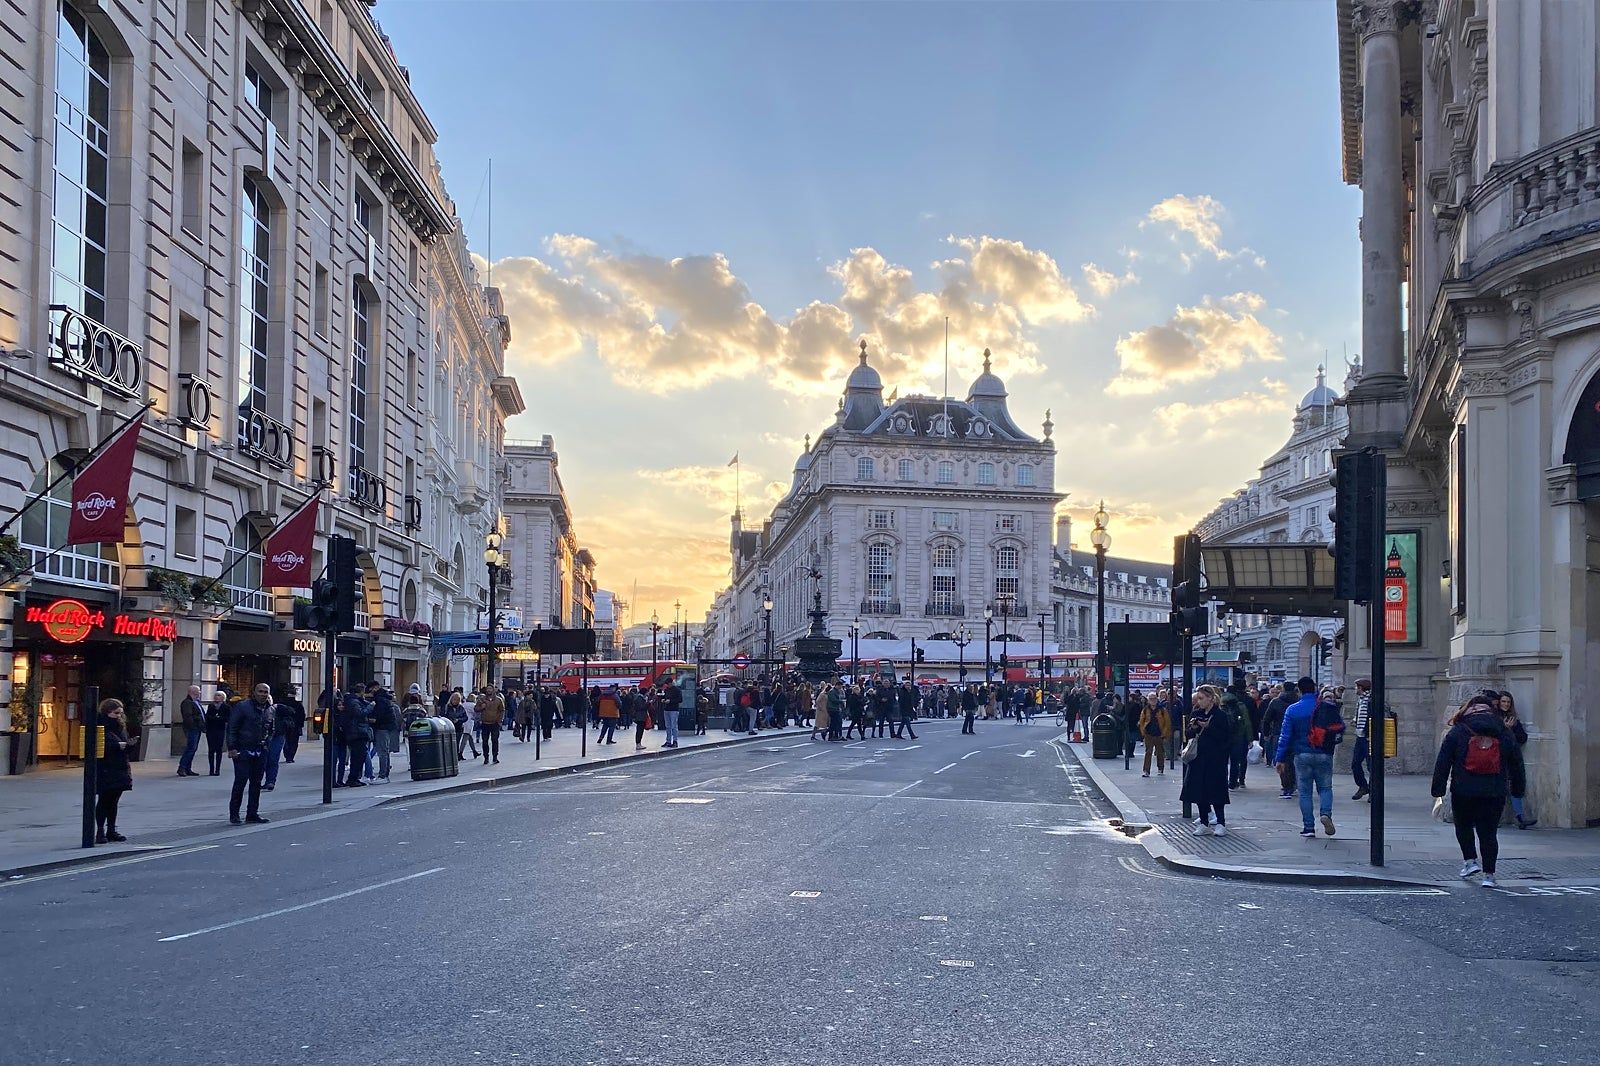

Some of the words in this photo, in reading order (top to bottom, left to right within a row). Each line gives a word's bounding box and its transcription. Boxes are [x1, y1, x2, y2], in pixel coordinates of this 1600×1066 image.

[76, 498, 94, 511] Hard
[94, 497, 116, 509] Rock
[272, 554, 287, 563] Hard
[287, 554, 305, 564] Rock
[26, 607, 69, 623] Hard
[69, 610, 105, 628] Rock
[114, 614, 152, 636] Hard
[151, 617, 173, 642] Rock
[499, 652, 539, 660] CRITERION
